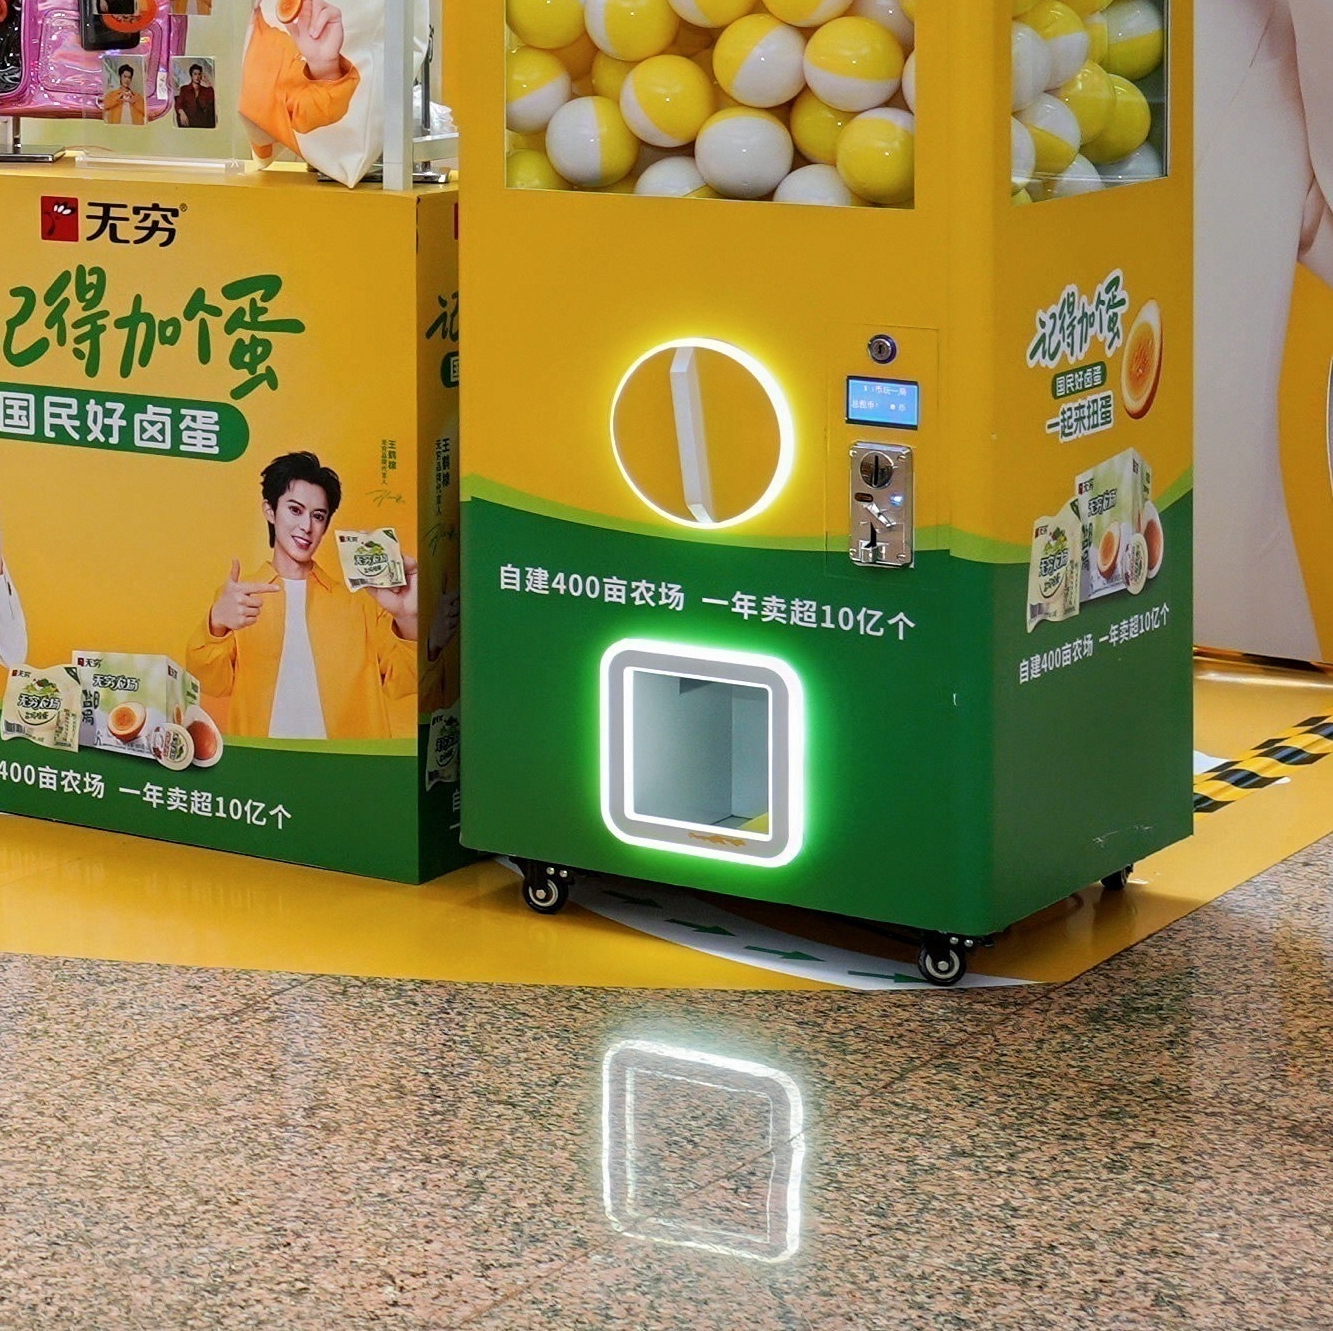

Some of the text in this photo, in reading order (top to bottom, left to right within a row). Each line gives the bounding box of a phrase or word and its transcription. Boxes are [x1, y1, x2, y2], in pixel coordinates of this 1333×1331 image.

[85, 201, 180, 248] 无穷
[1032, 274, 1127, 363] 记得加个蛋
[1055, 367, 1102, 396] 国民好卤蛋
[1046, 396, 1113, 438] 一起来扭蛋
[499, 561, 917, 641] 自建400亩农场 一年卖超10亿个
[1019, 604, 1170, 685] 自建400亩农场 一年卖超10亿个
[118, 782, 293, 829] 一年卖超10亿个
